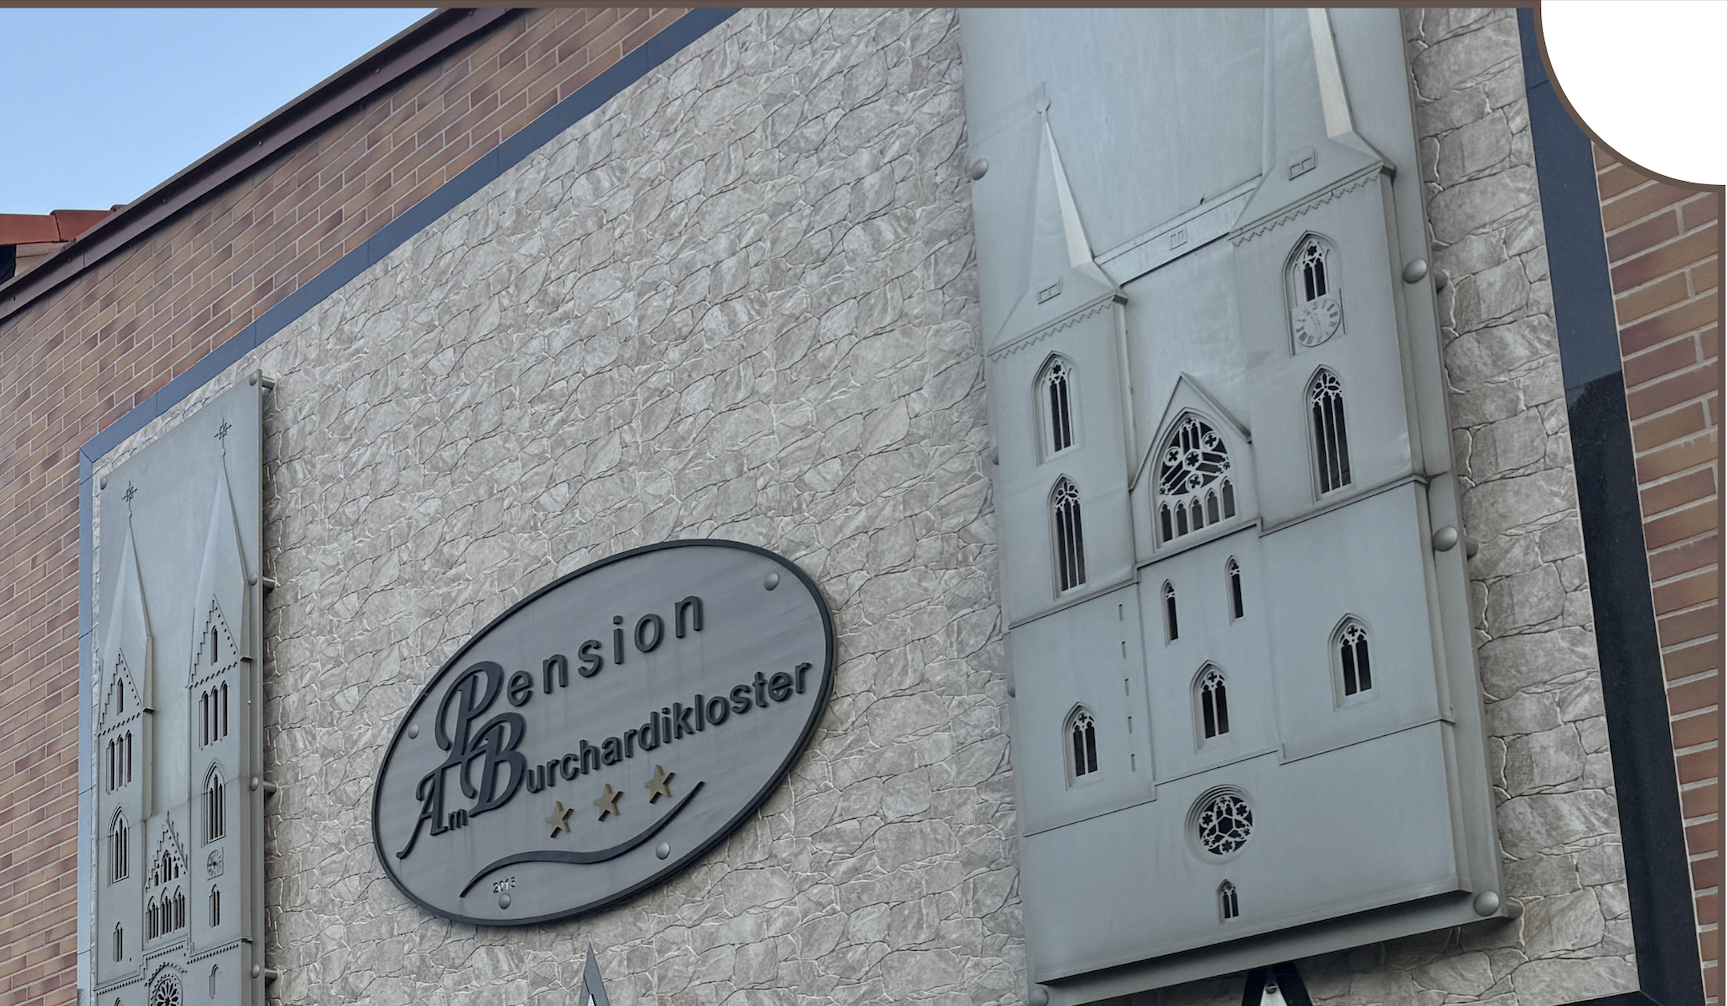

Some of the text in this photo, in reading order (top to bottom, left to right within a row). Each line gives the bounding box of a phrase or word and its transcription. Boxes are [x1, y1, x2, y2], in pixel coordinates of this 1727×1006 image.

[397, 661, 811, 858] Am Burchardikloster
[435, 595, 703, 765] Pension
